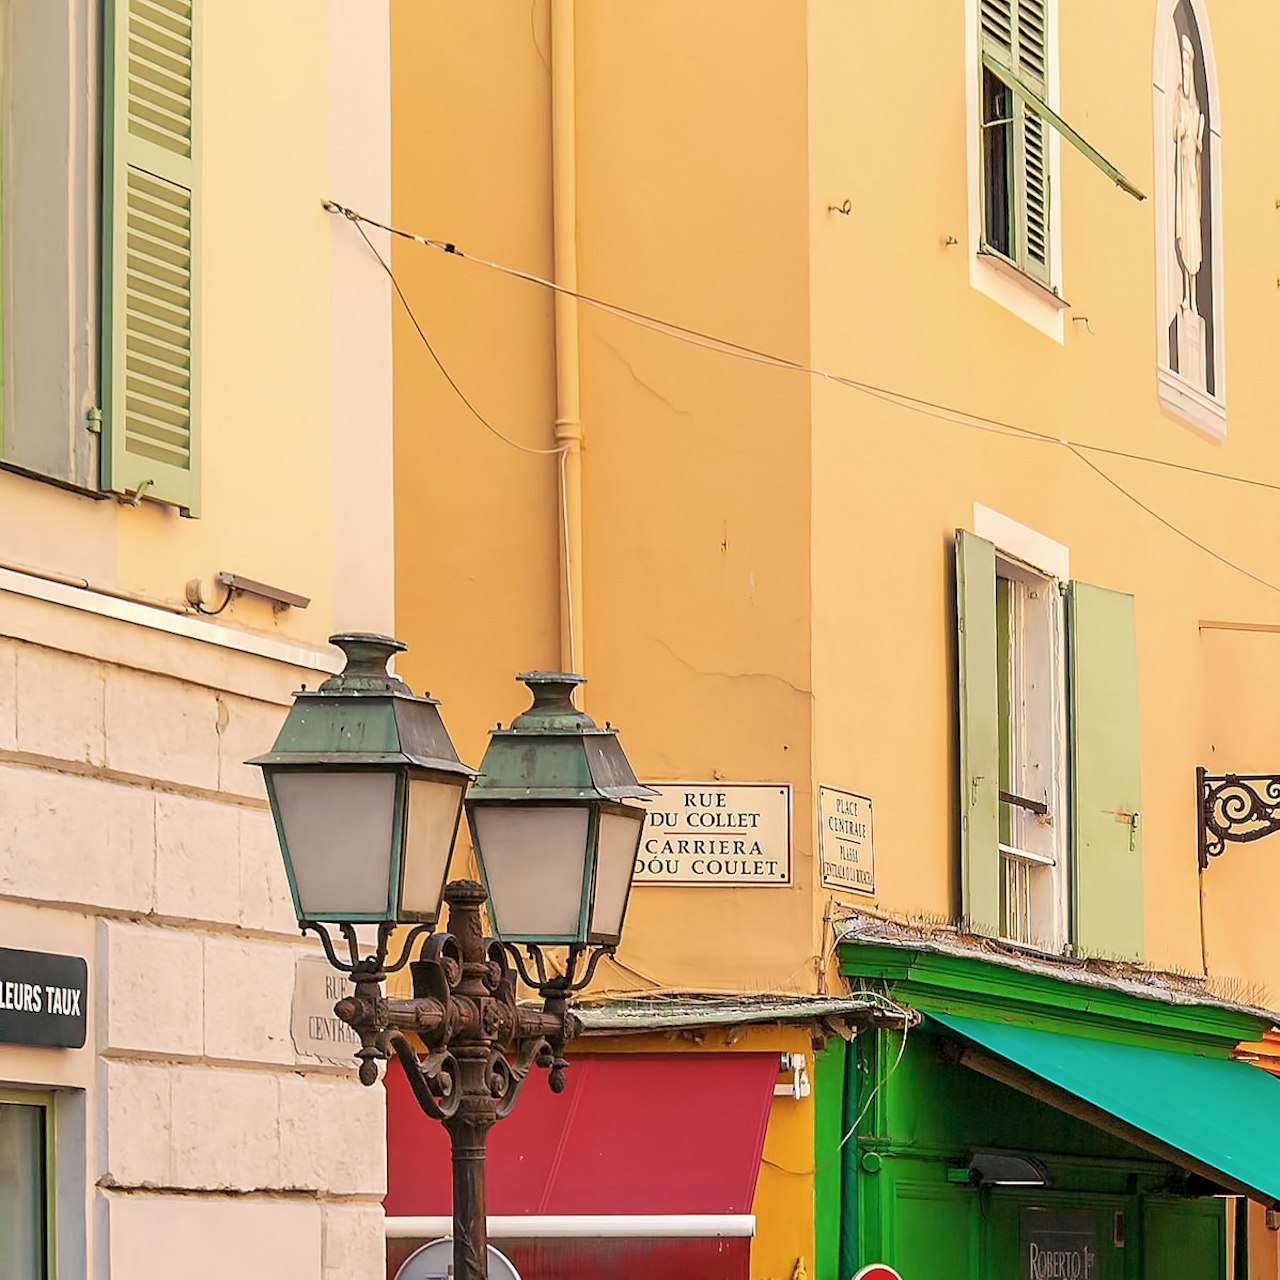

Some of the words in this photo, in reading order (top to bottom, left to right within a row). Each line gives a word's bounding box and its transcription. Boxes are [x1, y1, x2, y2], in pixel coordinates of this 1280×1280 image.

[684, 792, 727, 808] RUE
[836, 798, 858, 817] PLACE
[650, 812, 678, 828] DU
[686, 812, 761, 828] COLLET
[828, 816, 866, 839] CENTRALE
[645, 839, 764, 856] CARRIERA
[691, 859, 778, 876] COULET
[325, 975, 347, 1000] RUE
[46, 985, 81, 1018] TAUX
